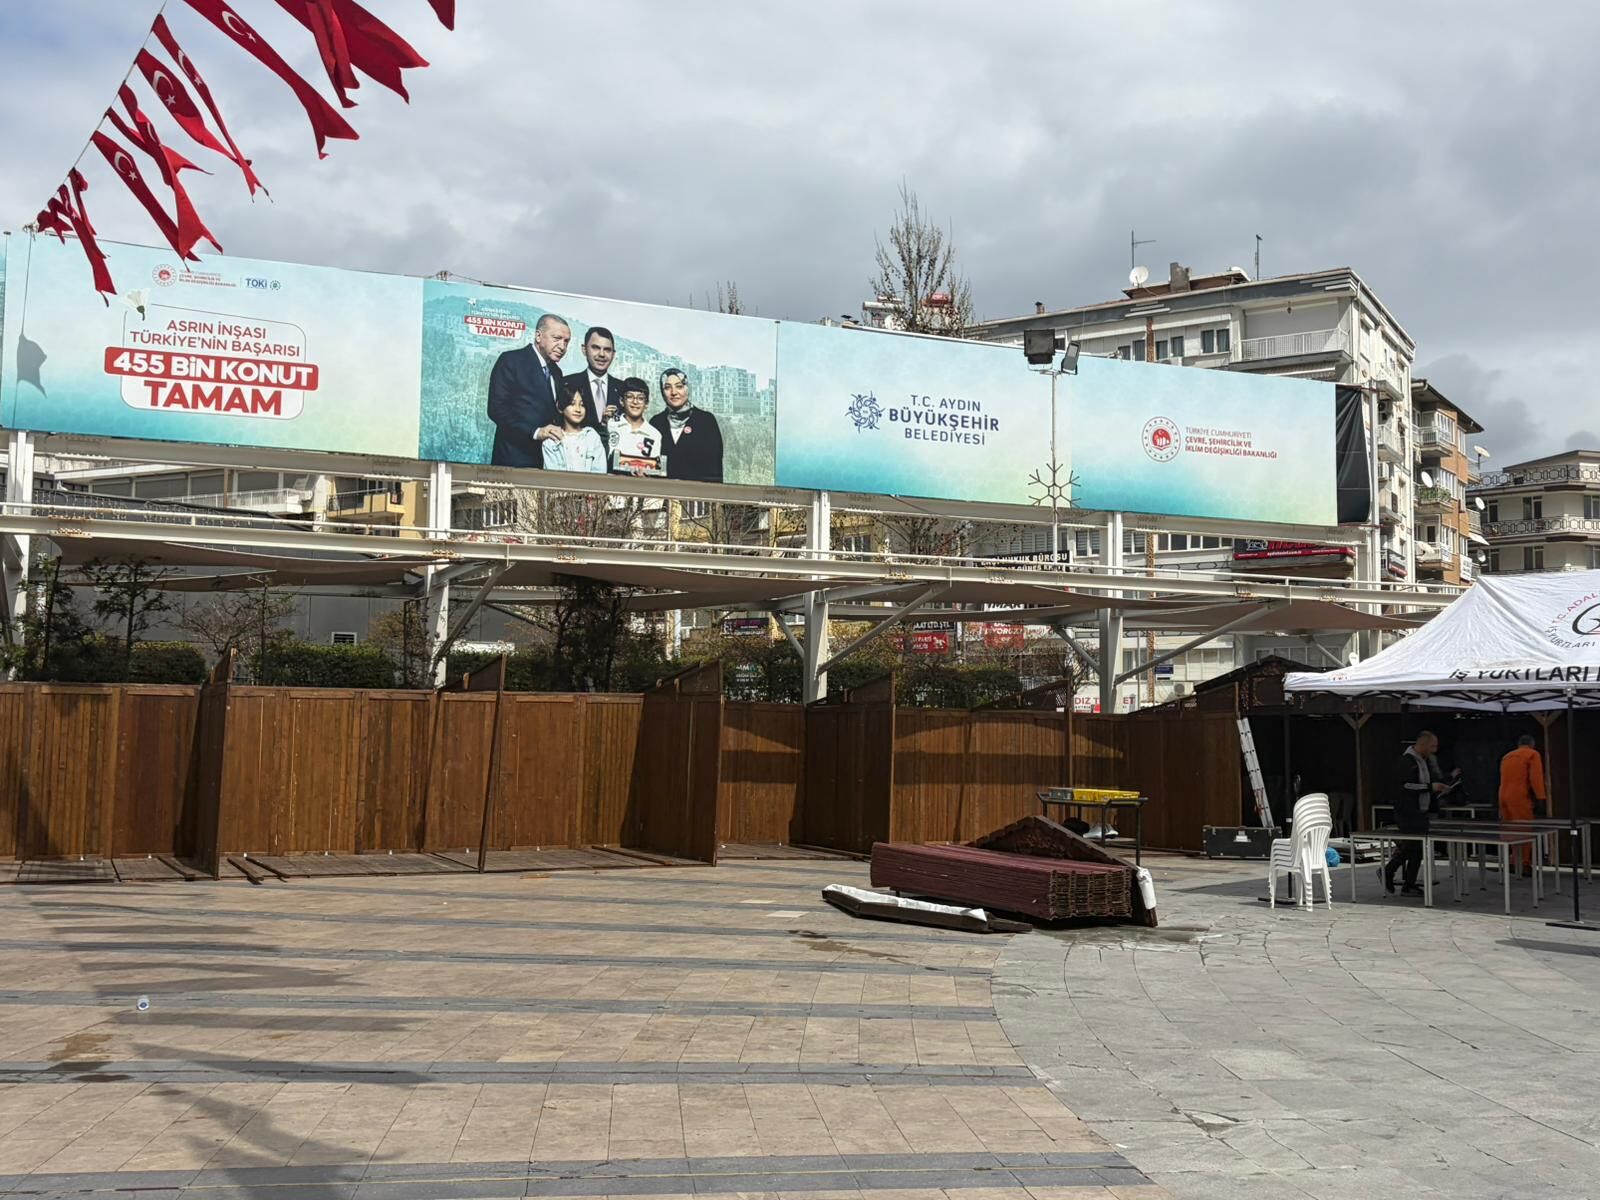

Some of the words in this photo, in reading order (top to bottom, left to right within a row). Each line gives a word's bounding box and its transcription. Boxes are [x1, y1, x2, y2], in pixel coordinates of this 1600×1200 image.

[166, 319, 214, 334] ASRIN
[217, 321, 266, 339] İNŞASI
[466, 316, 482, 324] 455
[496, 320, 524, 329] KONUT
[475, 325, 516, 338] TAMAM
[130, 329, 227, 350] TÜRKİYE'NİN
[231, 341, 300, 357] BAŞARISI
[113, 352, 165, 374] 455
[220, 360, 313, 386] KONUT
[144, 379, 282, 415] TAMAM
[910, 394, 935, 408] T.C.
[939, 398, 981, 412] AYDIN
[889, 406, 999, 431] BÜYÜKŞEHİR
[904, 427, 985, 445] BELEDİYESİ
[1209, 437, 1243, 447] ŞEHİRCİLİK
[1185, 445, 1203, 453] İKLİM
[1243, 450, 1277, 459] BAKANLIĞI
